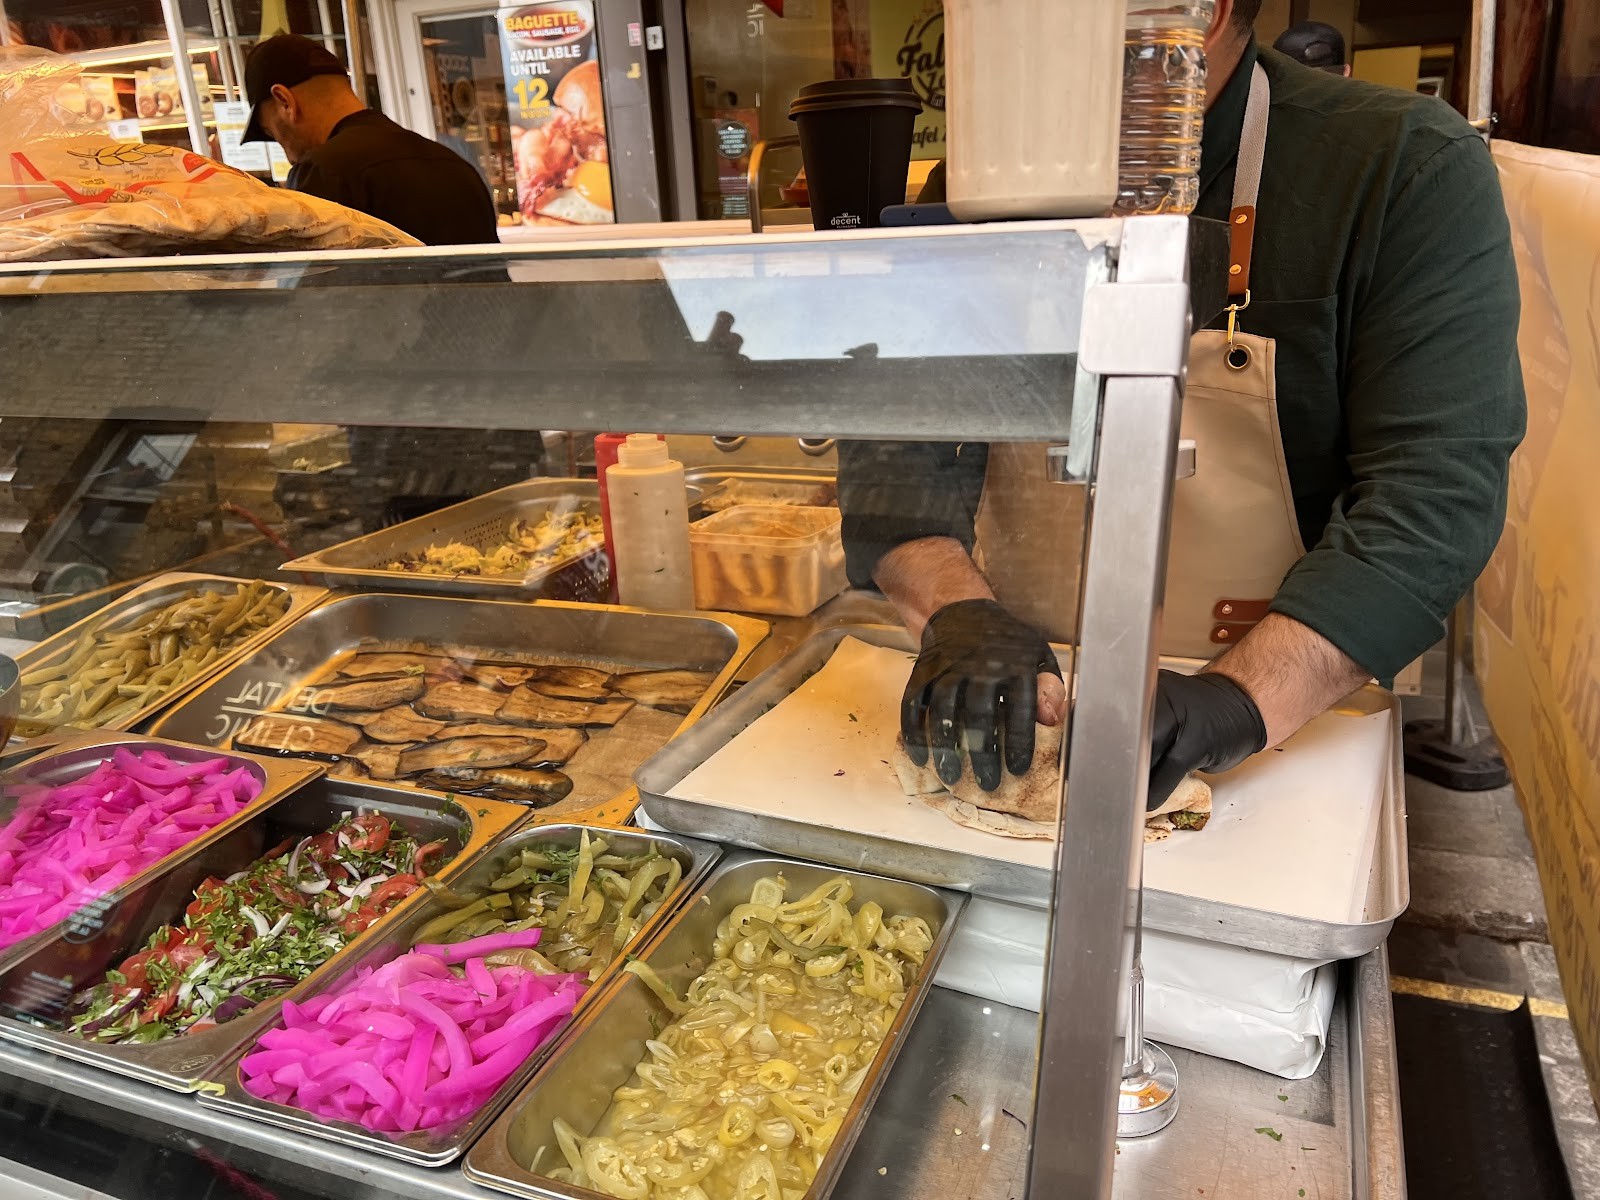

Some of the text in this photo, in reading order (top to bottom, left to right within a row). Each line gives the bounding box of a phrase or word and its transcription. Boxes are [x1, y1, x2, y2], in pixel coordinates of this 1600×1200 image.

[506, 11, 579, 31] BAGUETTE
[510, 45, 581, 62] AVAILABLE
[511, 61, 551, 76] UNTIL
[512, 77, 550, 110] 12
[830, 215, 861, 226] decent
